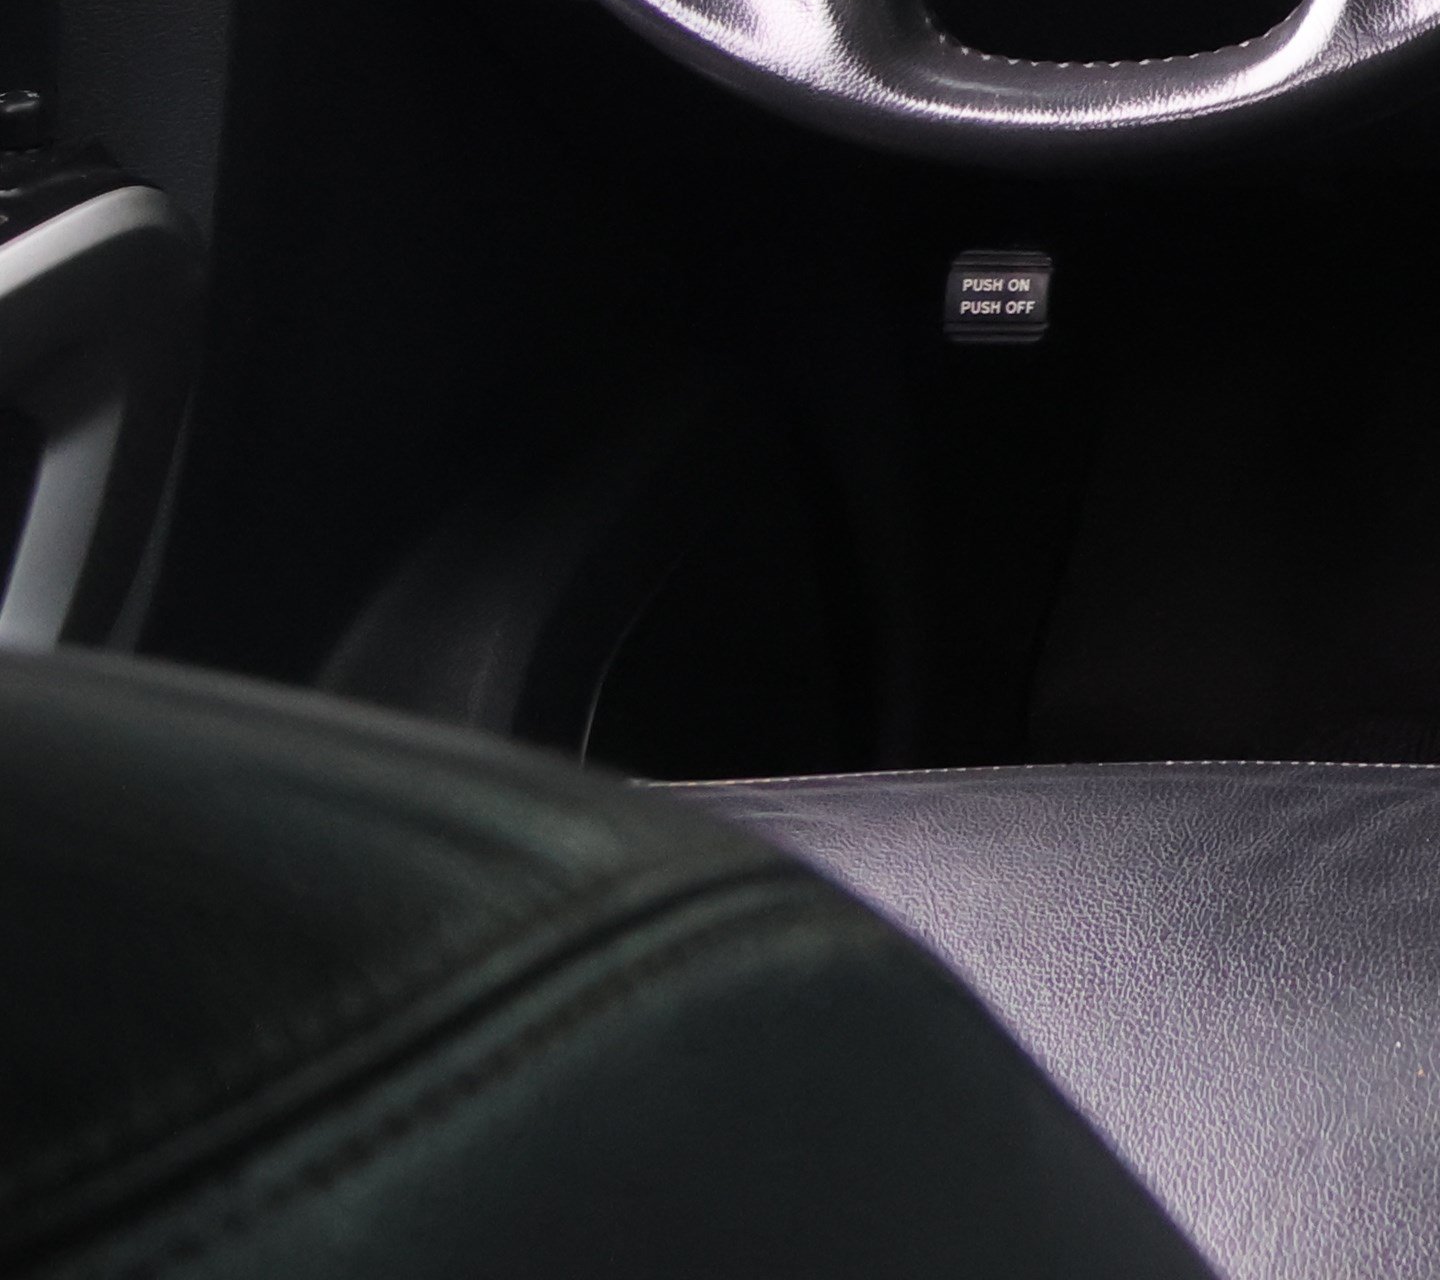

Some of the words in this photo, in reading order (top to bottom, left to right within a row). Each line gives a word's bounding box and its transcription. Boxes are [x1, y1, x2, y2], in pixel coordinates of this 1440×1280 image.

[962, 278, 1003, 291] PUSH
[1007, 278, 1031, 291] ON
[960, 301, 1001, 315] PUSH
[1005, 301, 1036, 314] OFF
